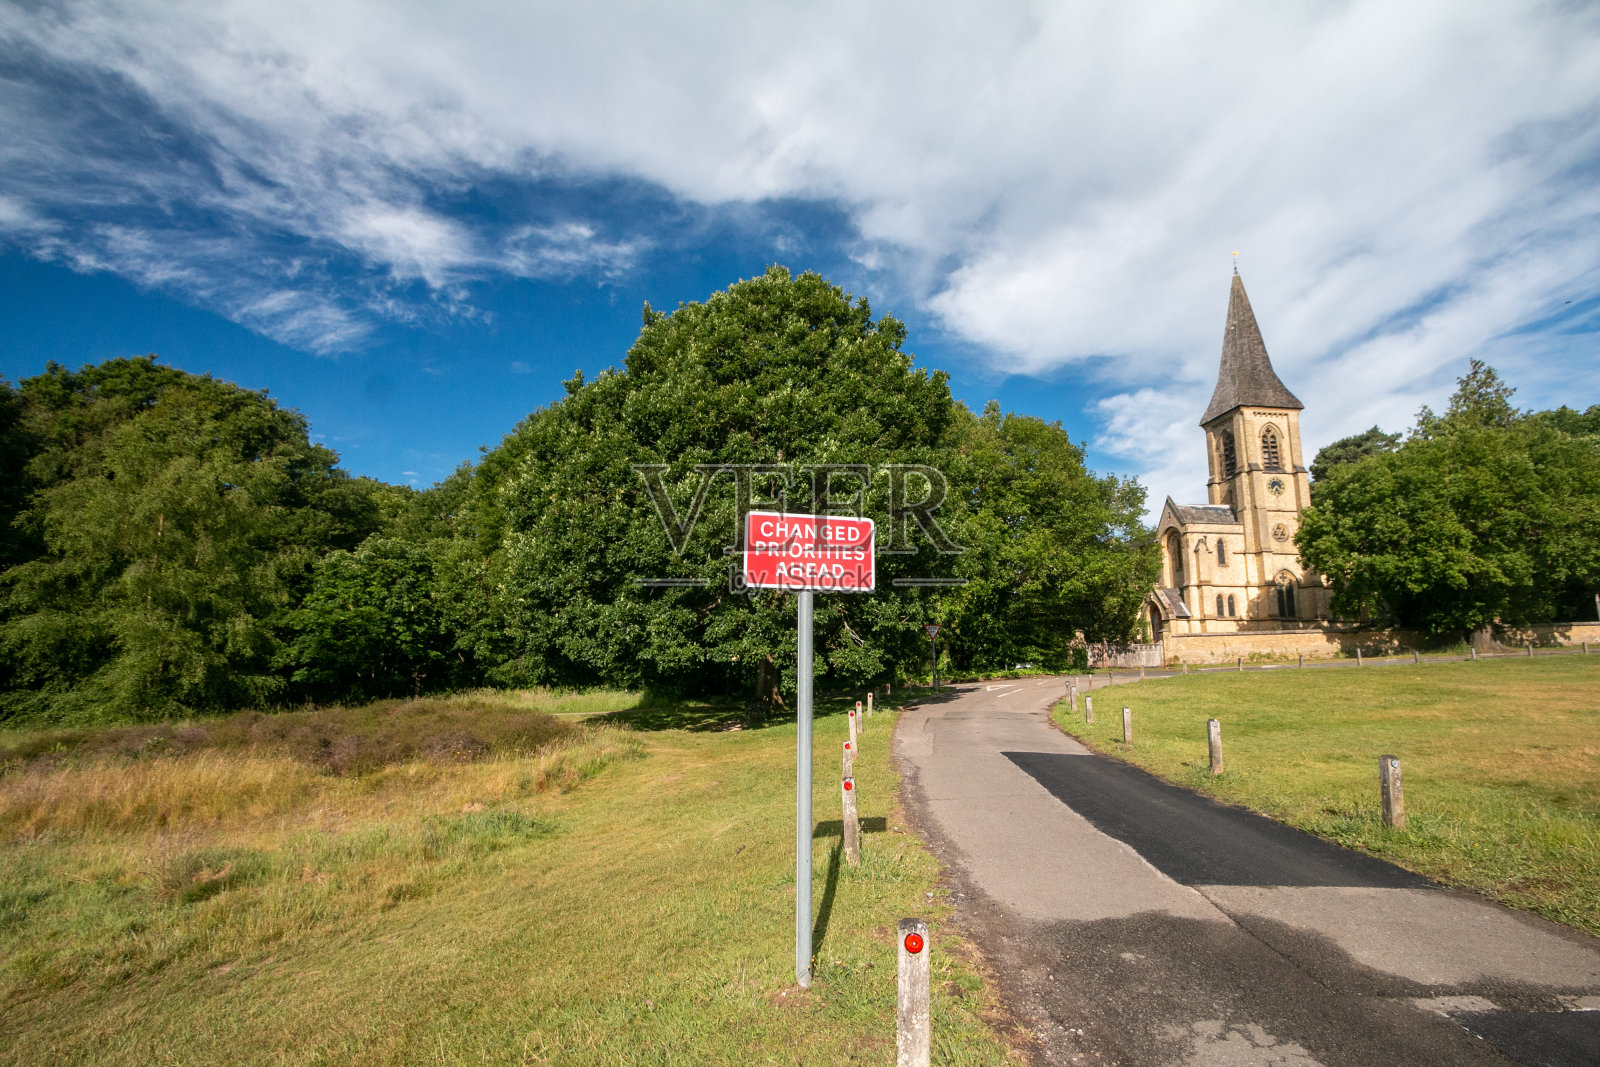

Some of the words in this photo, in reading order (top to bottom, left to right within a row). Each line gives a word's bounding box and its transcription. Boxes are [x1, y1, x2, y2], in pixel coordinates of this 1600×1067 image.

[760, 521, 860, 541] CHANGED
[756, 540, 865, 561] PRIORITIES
[775, 561, 845, 579] AHEAD
